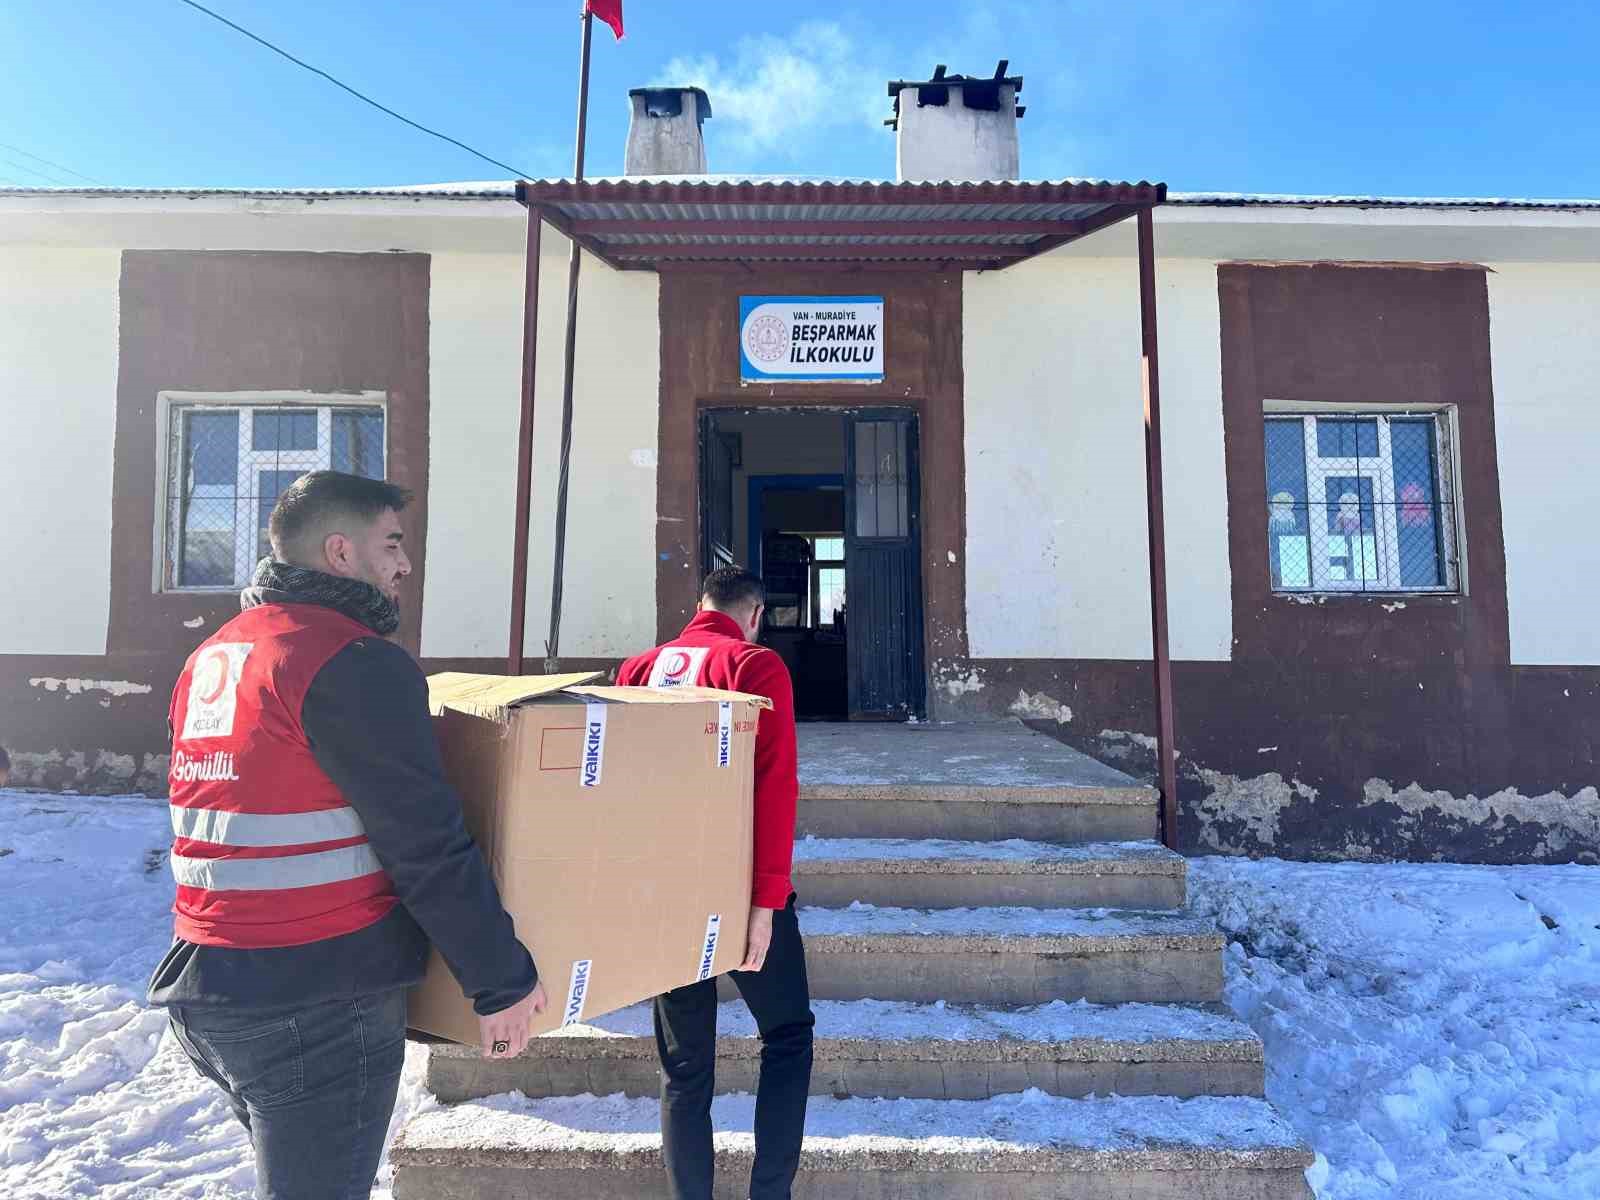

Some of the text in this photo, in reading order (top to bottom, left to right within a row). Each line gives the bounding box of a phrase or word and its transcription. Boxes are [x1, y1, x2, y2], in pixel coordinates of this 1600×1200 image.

[793, 311, 809, 320] VAN
[815, 309, 856, 320] MURADİYE
[792, 324, 877, 343] BEŞPARMAK
[790, 343, 874, 363] İLKOKULU
[172, 750, 239, 781] Gönüllü
